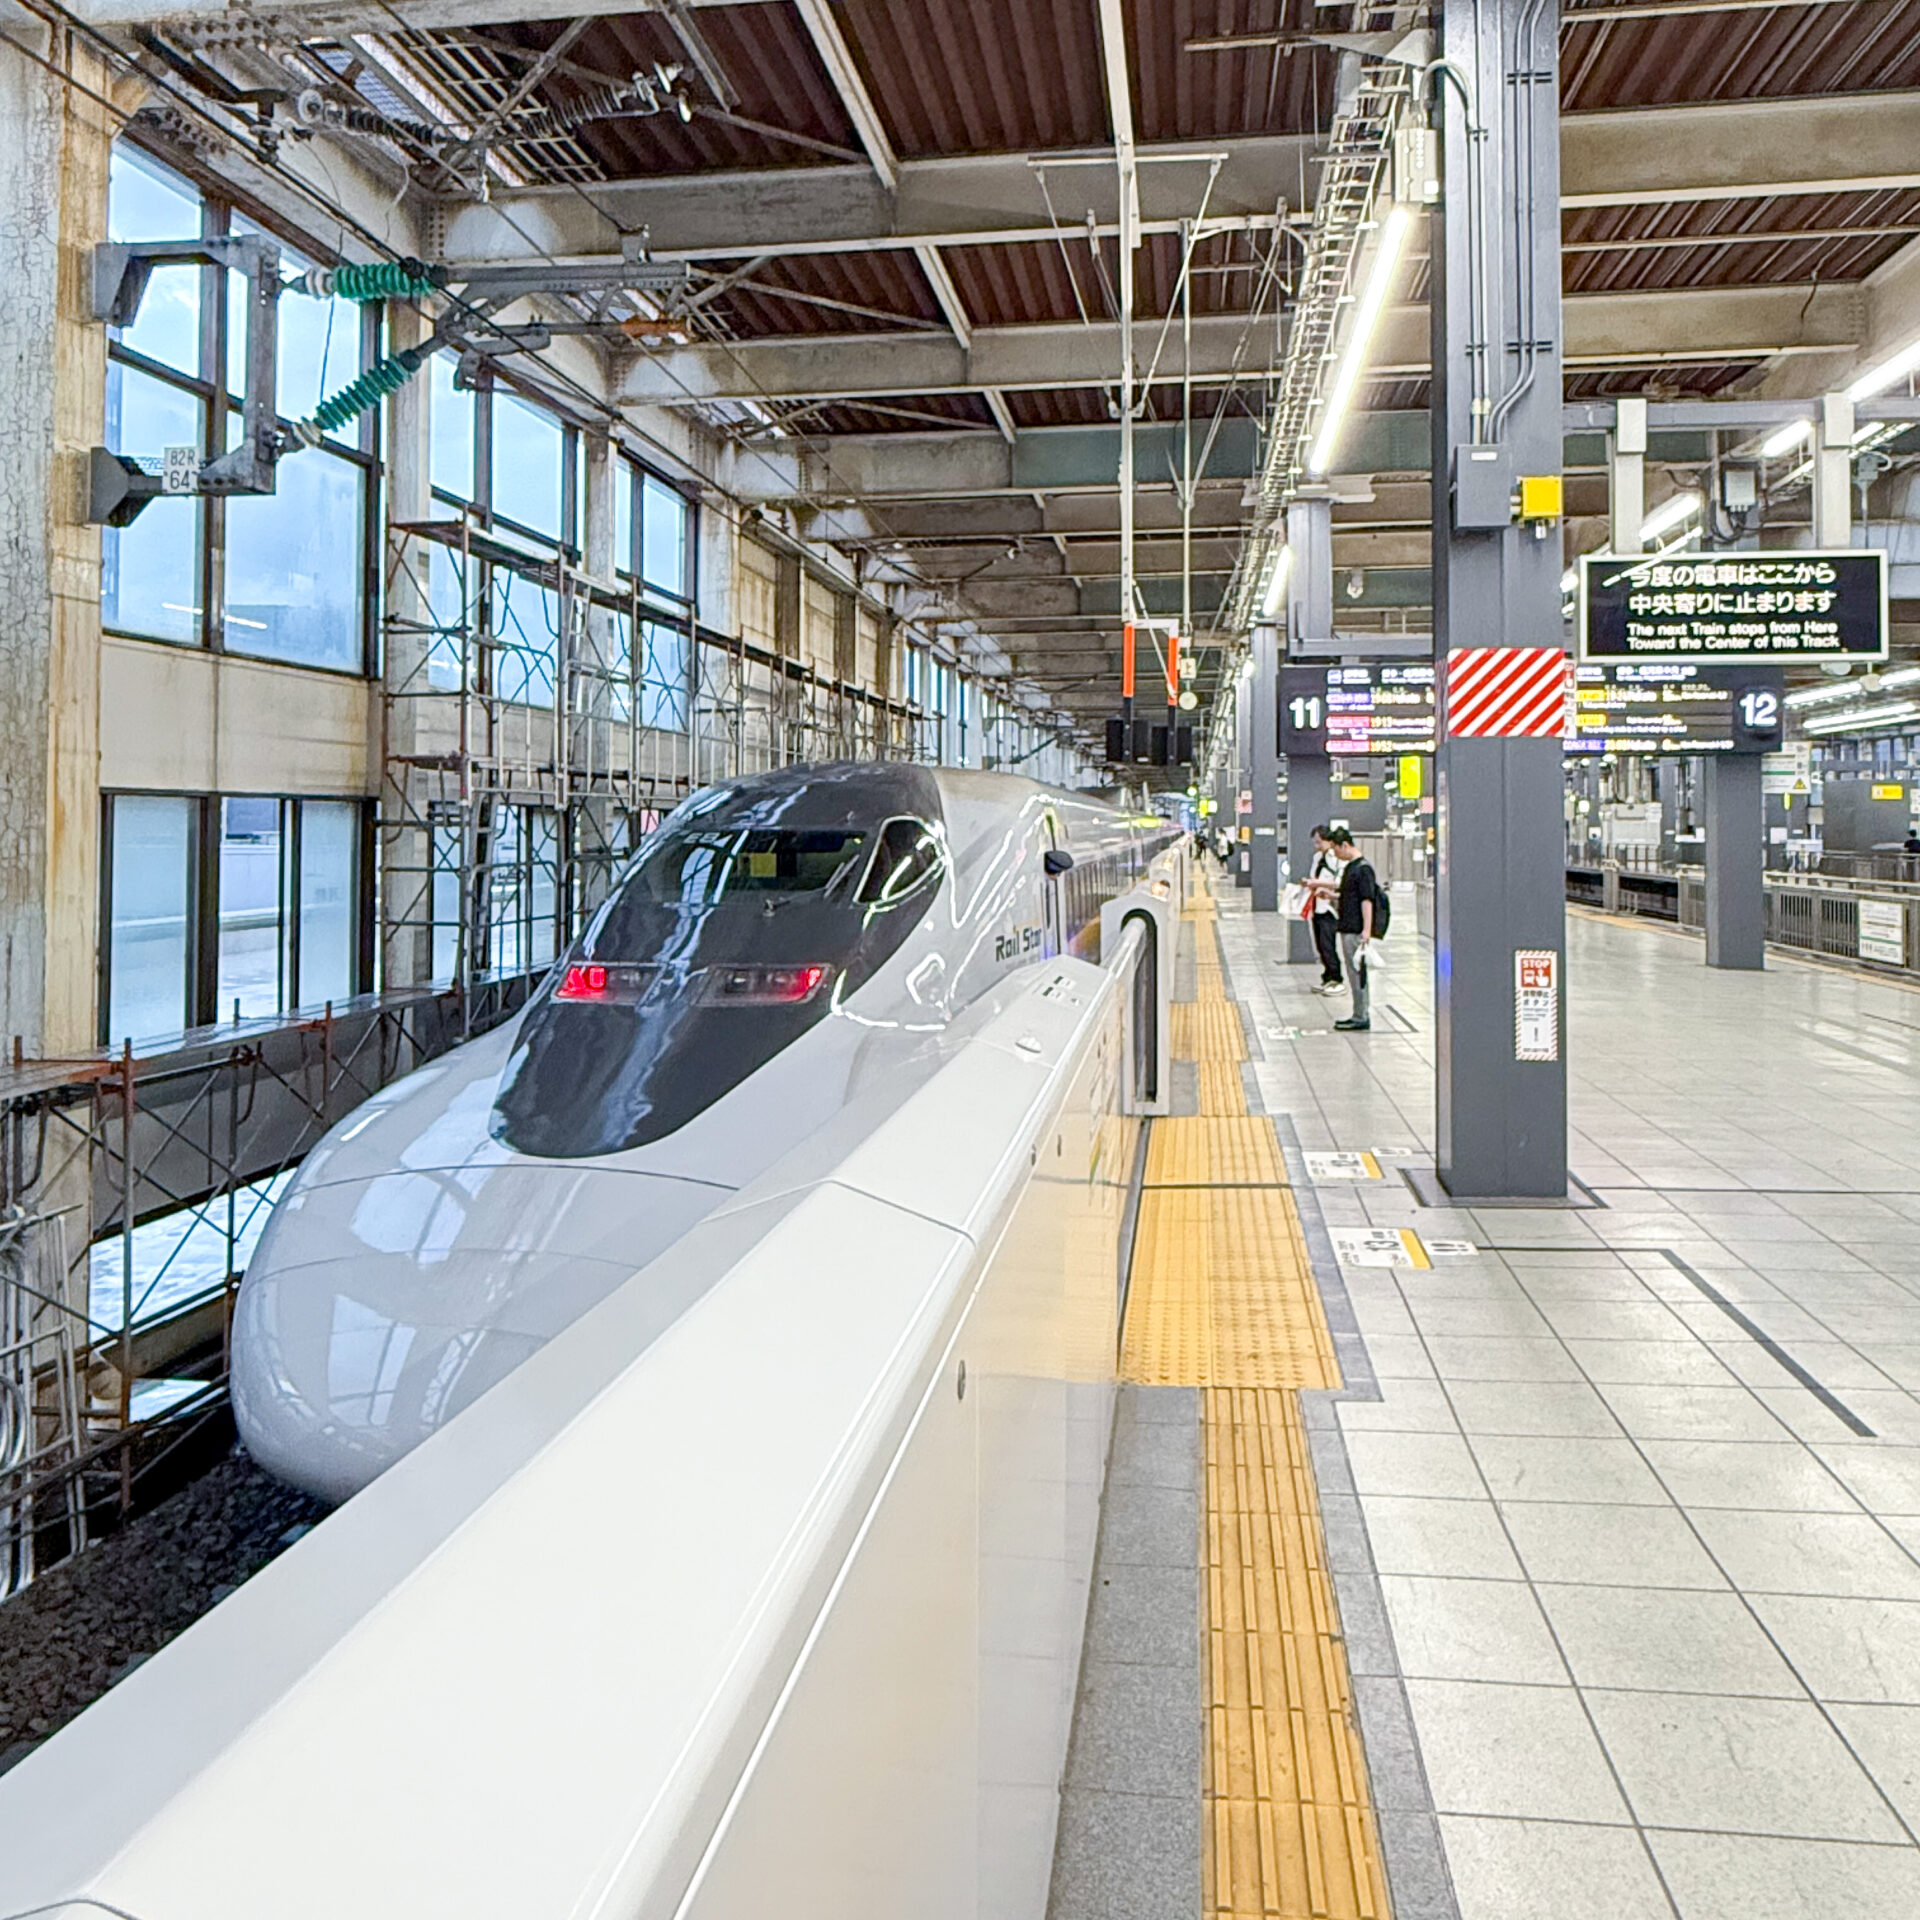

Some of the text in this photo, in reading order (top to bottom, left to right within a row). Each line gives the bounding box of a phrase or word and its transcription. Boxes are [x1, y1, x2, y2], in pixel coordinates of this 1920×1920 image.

[170, 449, 196, 466] 82R
[170, 470, 190, 490] 64
[1629, 563, 1836, 588] 今度の電車はここから
[1629, 591, 1837, 615] 中央寄りに止まります
[1626, 620, 1838, 636] The next Train stops from Here
[1626, 633, 1840, 650] Toward the Center of this Track
[1289, 697, 1320, 729] 11
[1740, 692, 1777, 727] 12
[995, 924, 1020, 963] Rail
[1523, 959, 1550, 969] STOP
